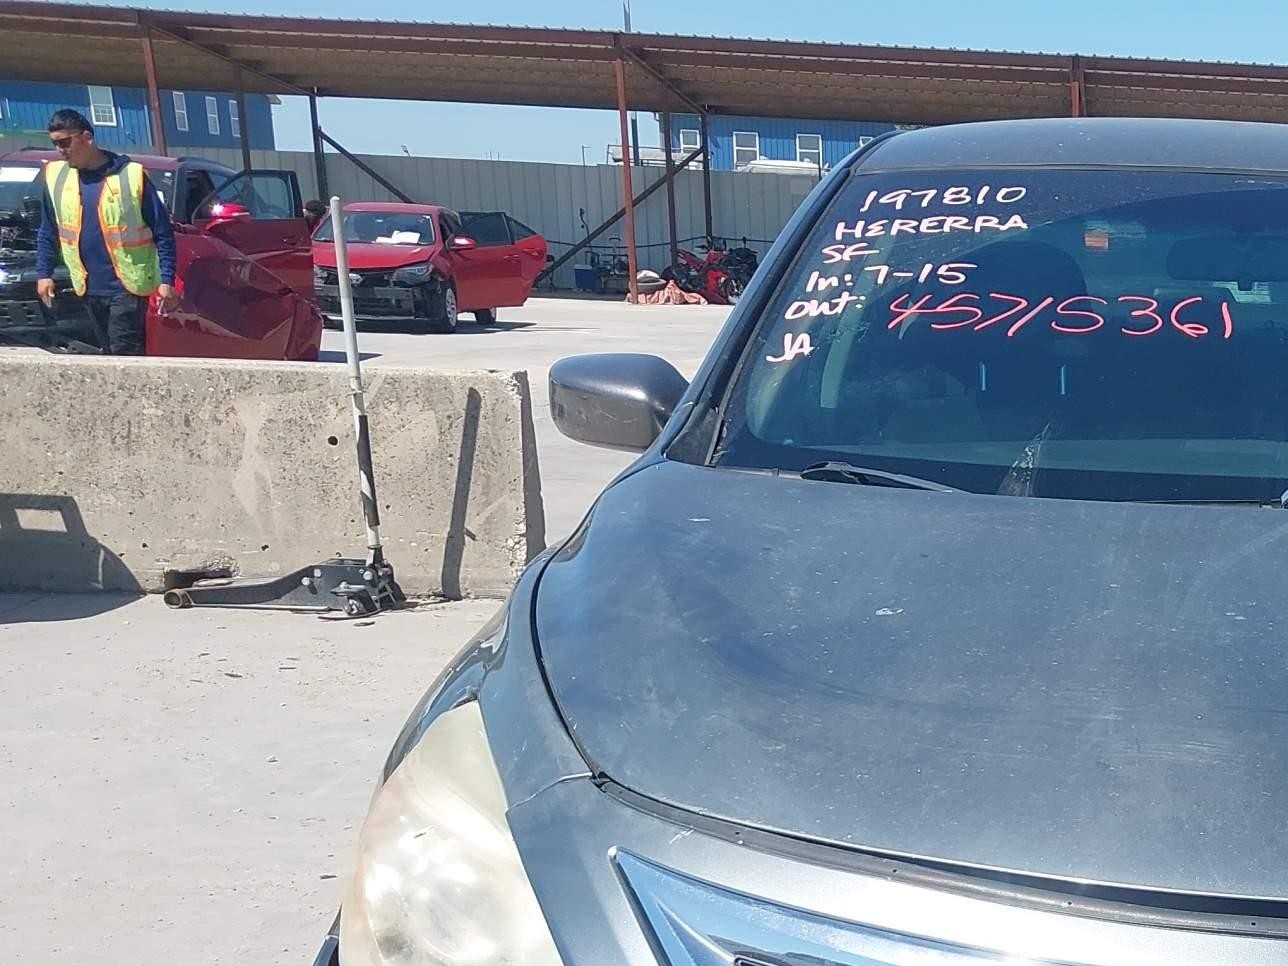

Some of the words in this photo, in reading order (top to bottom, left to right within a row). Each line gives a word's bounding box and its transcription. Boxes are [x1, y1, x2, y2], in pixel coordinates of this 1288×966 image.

[860, 186, 1027, 212] 197810
[835, 213, 1029, 241] HERERRA
[821, 243, 880, 265] SF
[805, 270, 854, 293] In:
[863, 262, 978, 286] 7-15
[886, 292, 1234, 340] 45715361
[765, 332, 816, 363] JA
